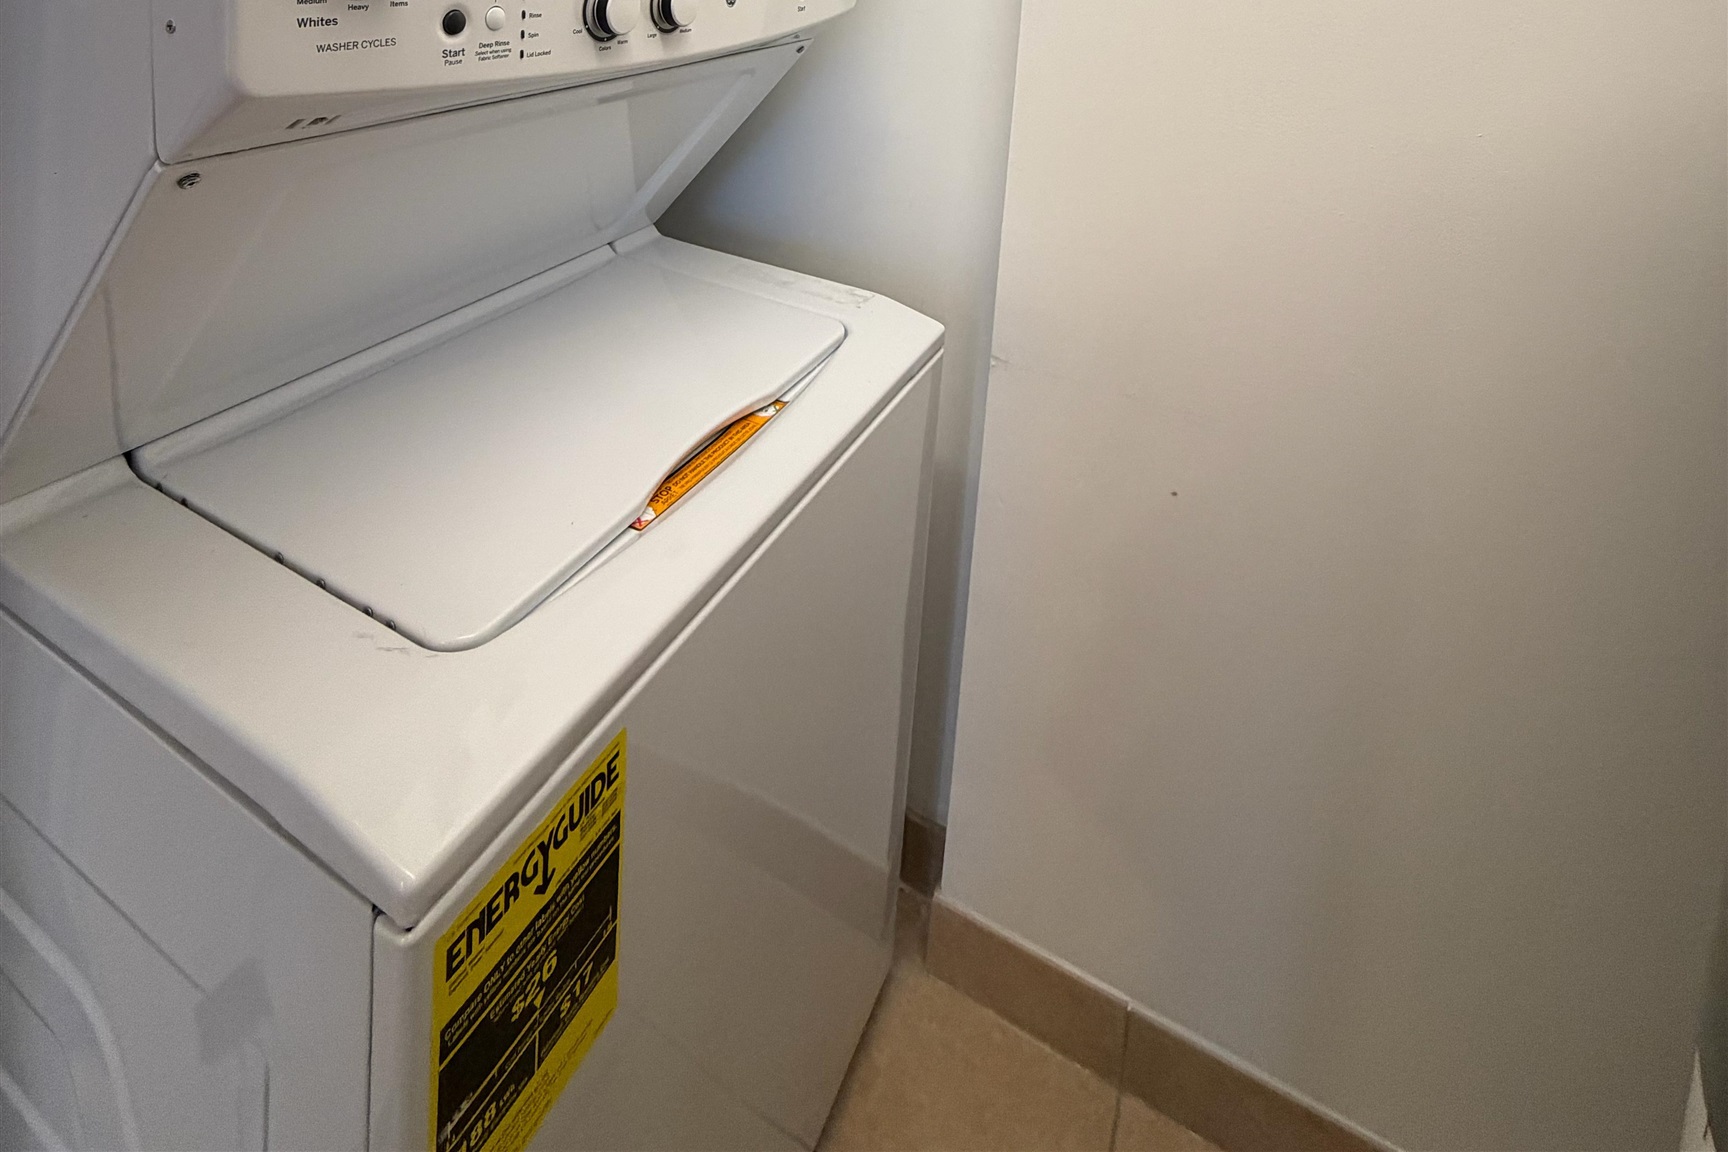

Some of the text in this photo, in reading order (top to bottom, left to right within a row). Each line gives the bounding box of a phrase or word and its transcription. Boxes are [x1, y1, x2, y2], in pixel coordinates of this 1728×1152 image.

[347, 4, 370, 12] Heavy
[389, 0, 409, 8] Items
[797, 5, 806, 13] Start
[528, 11, 543, 19] Rinse
[296, 18, 339, 29] Whites
[316, 37, 397, 53] WASHER CYCLES
[441, 47, 466, 59] Start
[474, 49, 489, 57] Select
[534, 49, 552, 57] Locked
[444, 57, 463, 67] Pause
[650, 485, 672, 504] STOP
[445, 750, 620, 983] ENERGYGUIDE
[511, 948, 557, 1023] $26
[560, 961, 593, 1019] $17
[445, 993, 482, 1041] Compare
[484, 961, 505, 993] ONLY
[507, 953, 514, 965] to
